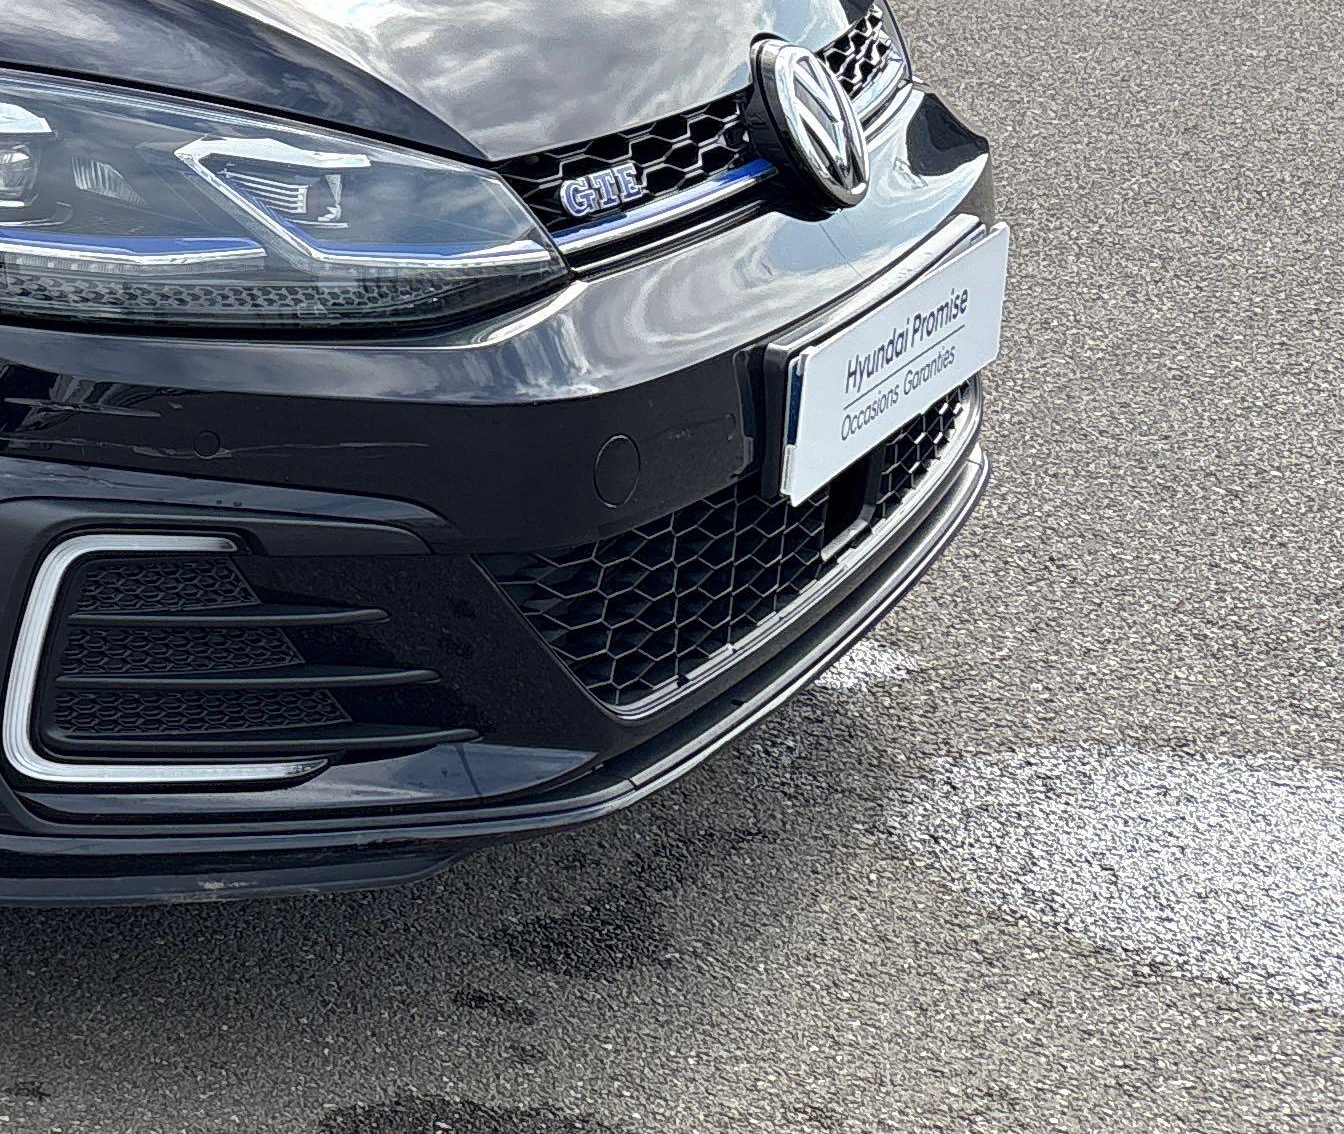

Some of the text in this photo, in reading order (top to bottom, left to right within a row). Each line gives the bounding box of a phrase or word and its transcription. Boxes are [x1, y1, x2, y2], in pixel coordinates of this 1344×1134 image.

[559, 162, 643, 217] GTE
[844, 287, 968, 394] Hyundai Promise
[840, 344, 955, 441] Occasions Garanties
